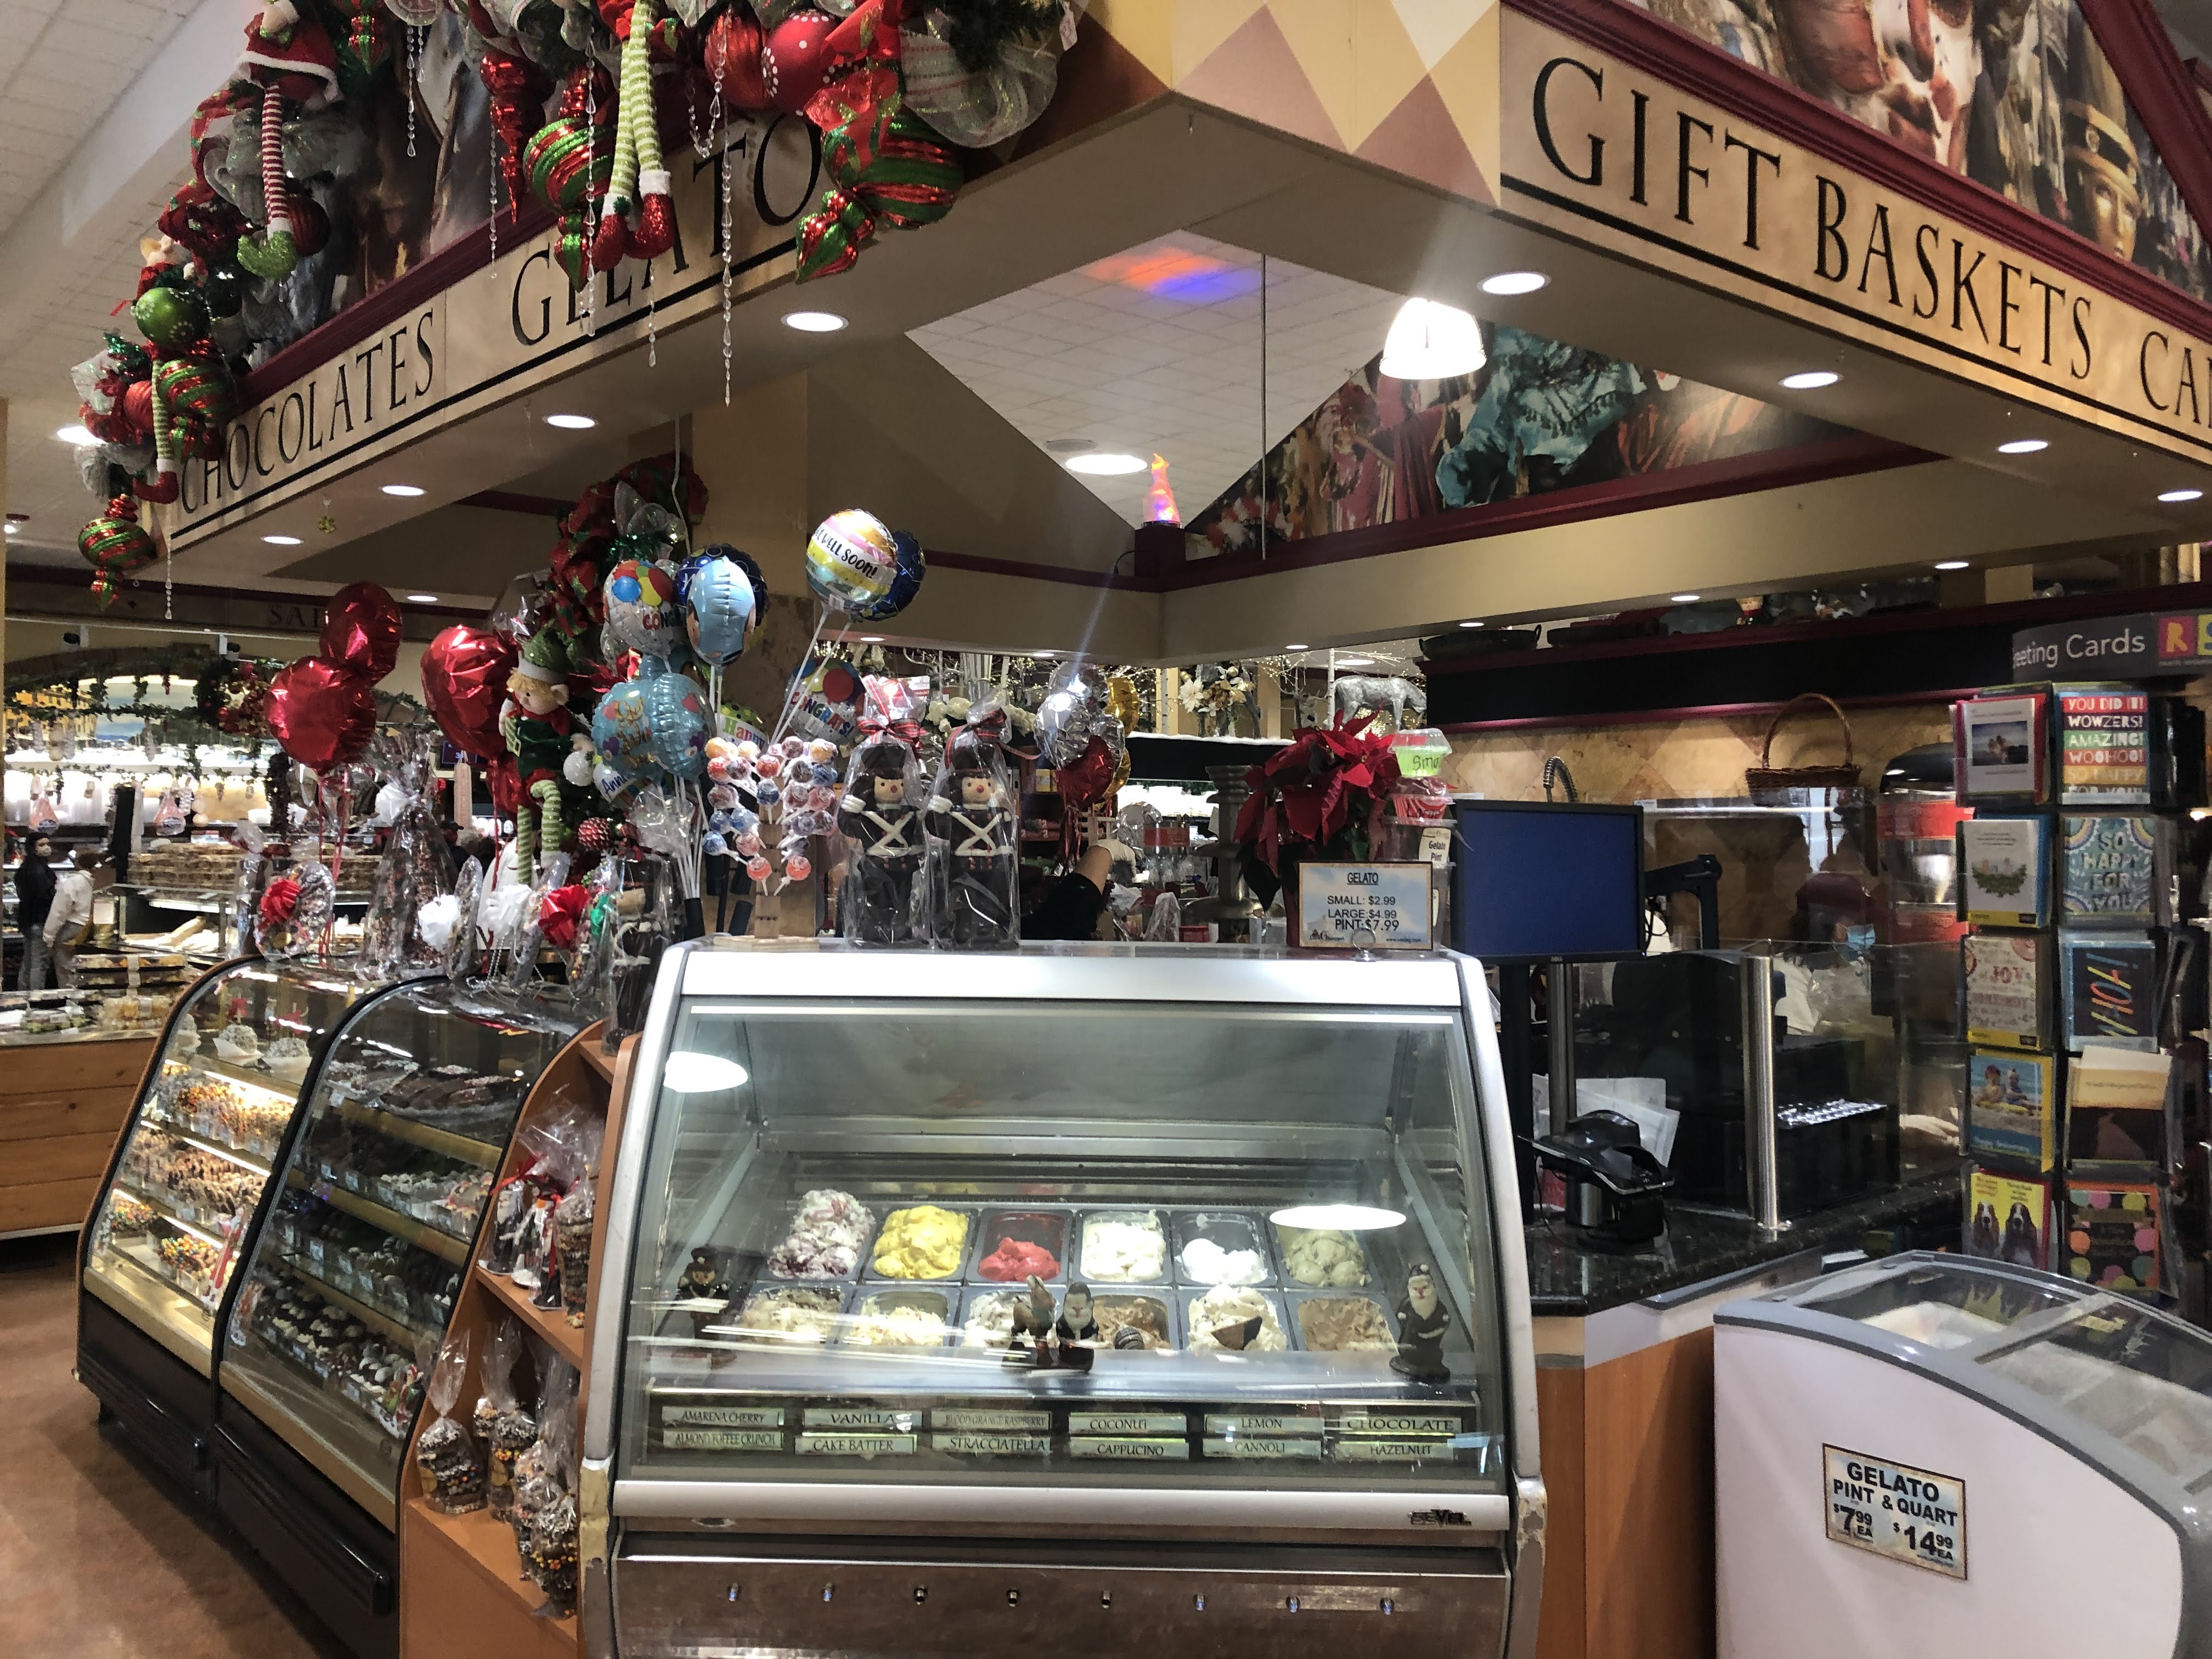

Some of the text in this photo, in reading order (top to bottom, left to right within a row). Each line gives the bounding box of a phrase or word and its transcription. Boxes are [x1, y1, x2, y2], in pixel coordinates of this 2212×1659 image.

[1533, 57, 1780, 250] GIFT
[1814, 175, 2091, 380] BASKETS
[182, 308, 433, 514] CHOCOLATES
[841, 548, 879, 578] SOON!
[2013, 628, 2146, 668] eeting Cards
[2068, 698, 2095, 711] YOU
[2100, 697, 2123, 710] DID
[2068, 715, 2143, 728] WOWZERS!
[2068, 732, 2144, 747] AMAZING!
[1413, 755, 1440, 770] Sma
[2068, 749, 2144, 764] WOOHOO!
[1347, 872, 1379, 884] GELATO
[1327, 895, 1396, 905] SMALL: $2.99
[681, 1410, 765, 1423] AMARENA CHERRY
[831, 1413, 896, 1424] VANILLA
[1005, 1415, 1046, 1426] RASPBERRY
[1090, 1418, 1147, 1429] COCONUT
[1241, 1418, 1282, 1429] LEMON
[1347, 1418, 1454, 1430] CHOCOLATE
[741, 1433, 776, 1445] CRUNCH
[813, 1440, 894, 1451] CAKE BATTER
[950, 1437, 1046, 1451] STRACCIATELLA
[1097, 1443, 1164, 1456] CAPPUCINO
[1234, 1442, 1285, 1452] CANNOLI
[1371, 1444, 1432, 1455] HAZELNUT
[1847, 1462, 1940, 1502] GELATO
[1833, 1479, 1958, 1527] PINT & QUART
[1857, 1525, 1873, 1537] EA
